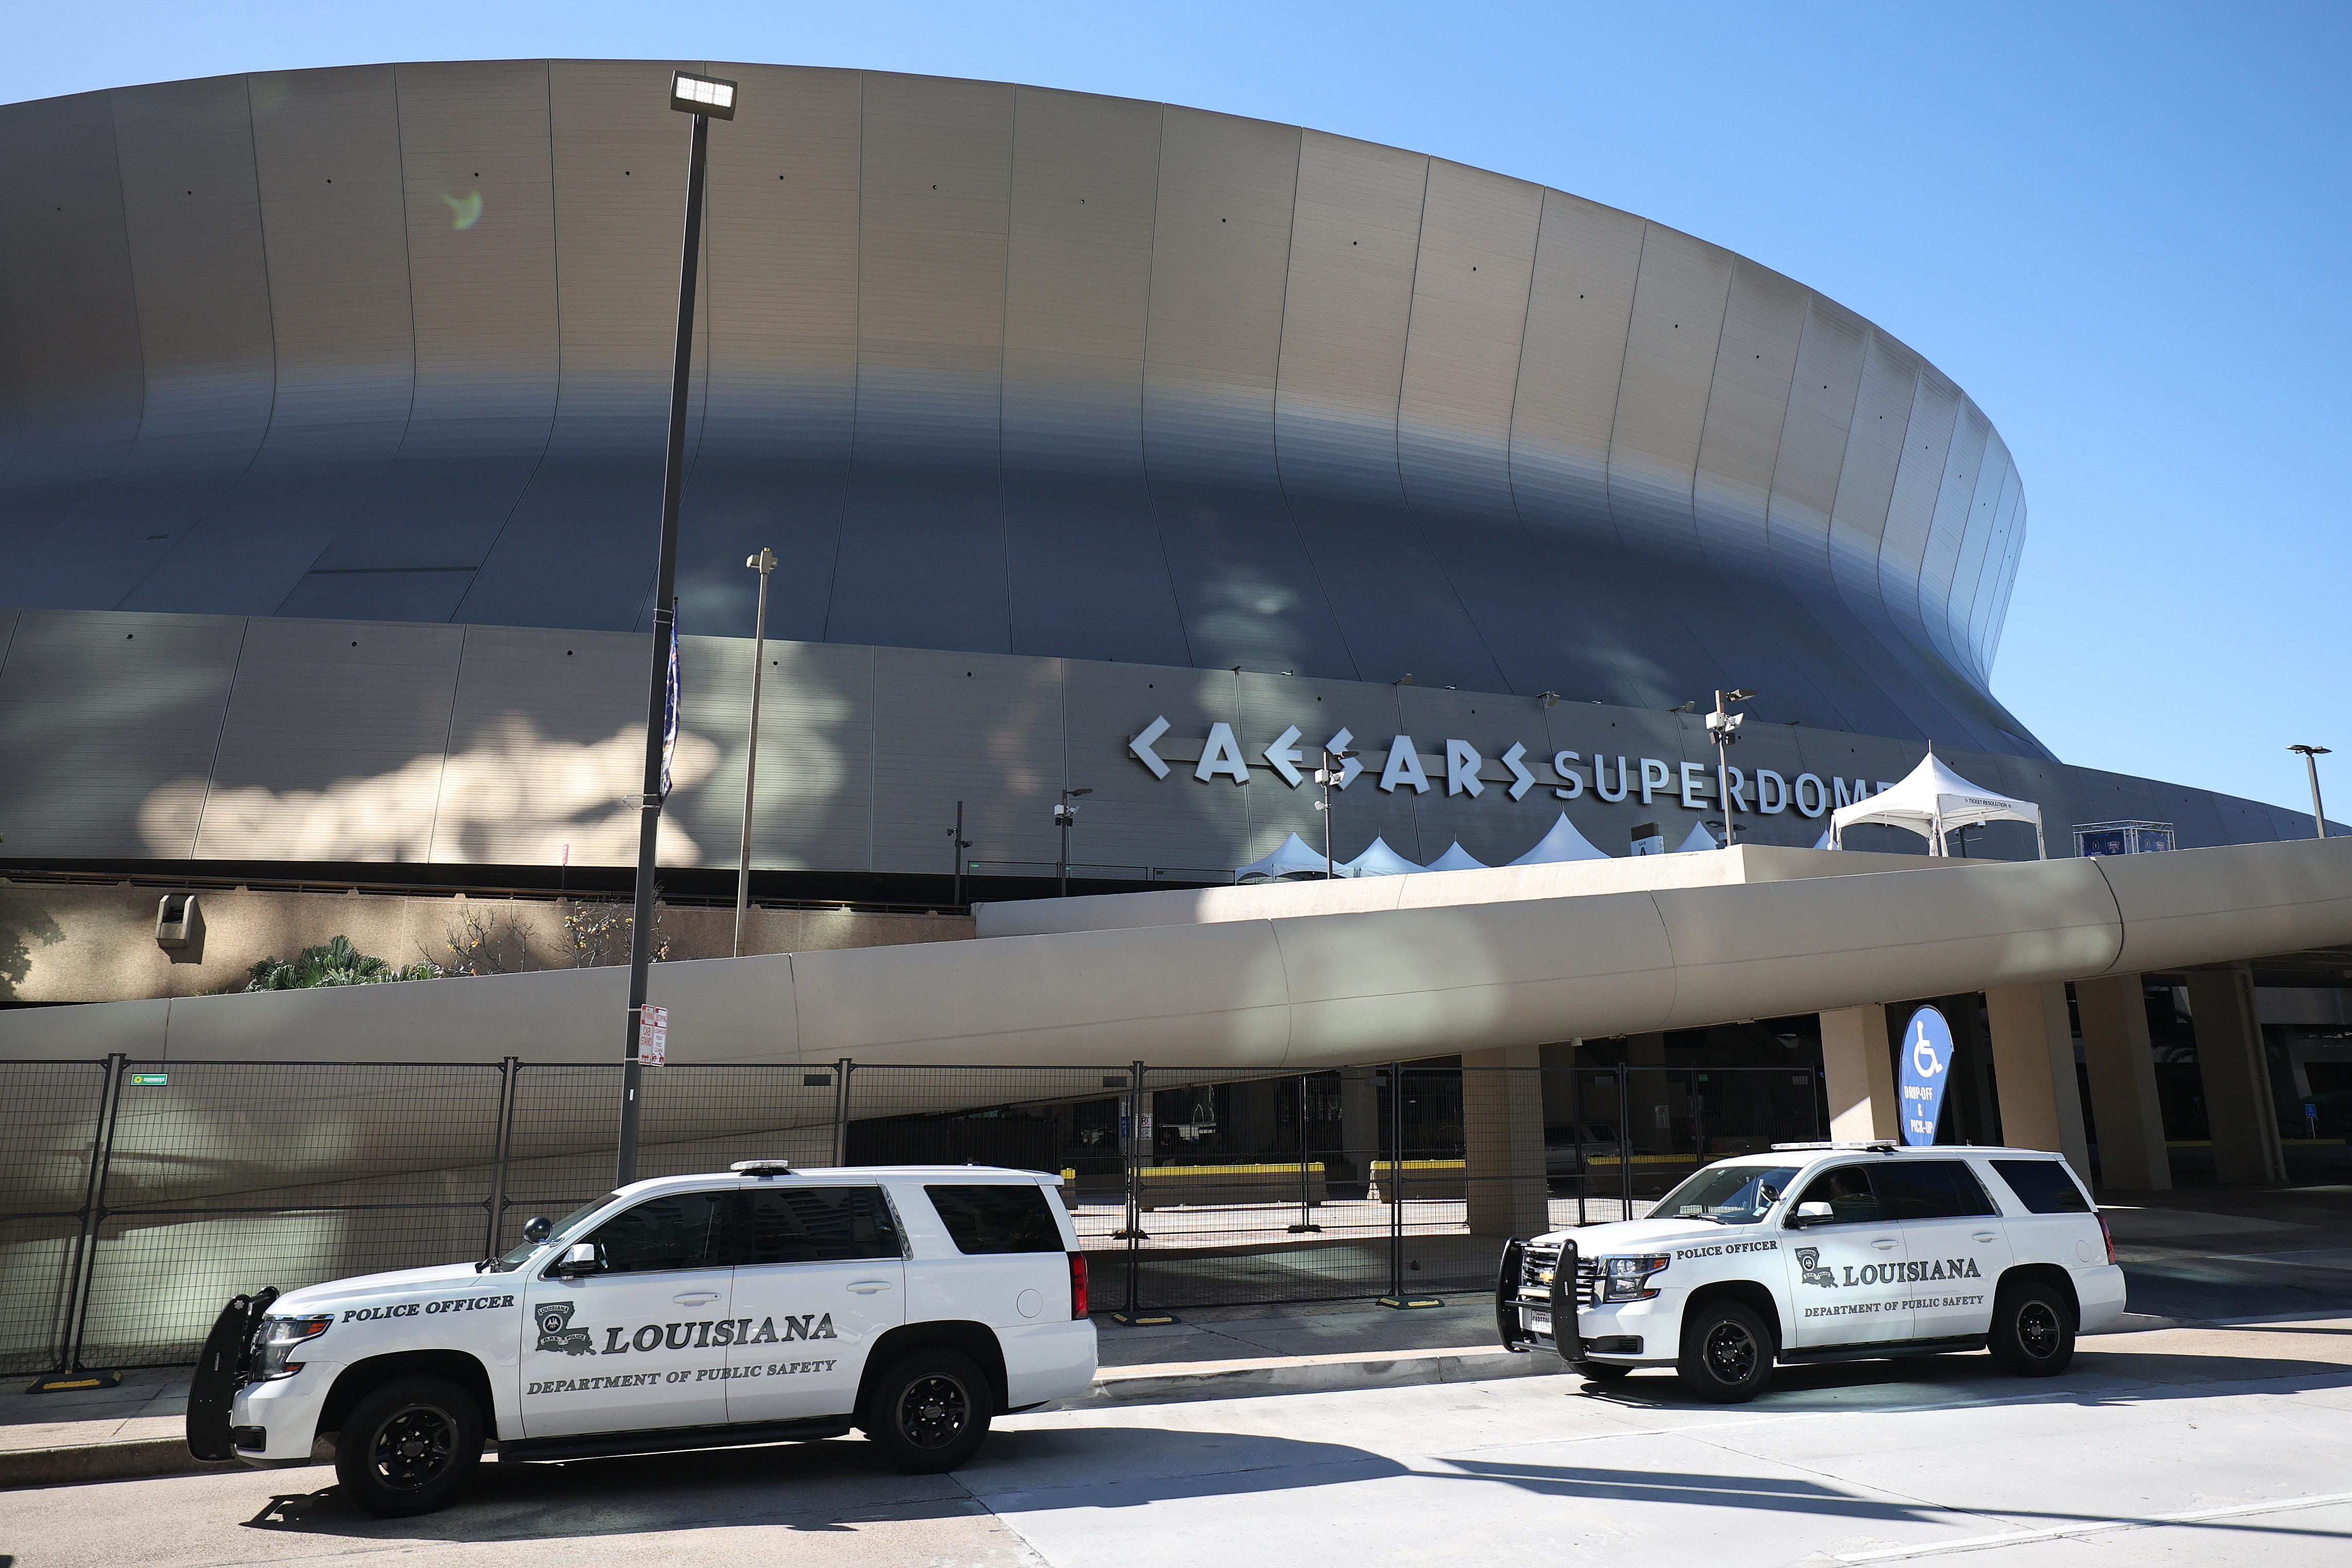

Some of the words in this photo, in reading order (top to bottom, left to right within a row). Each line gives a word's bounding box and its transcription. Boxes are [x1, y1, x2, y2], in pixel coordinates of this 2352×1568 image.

[1129, 714, 1536, 802] CAESARS
[1554, 750, 1897, 819] SUPERDOM
[640, 1036, 652, 1046] STAND
[1904, 1086, 1933, 1101] DROP-OFF
[1918, 1103, 1923, 1117] &
[1910, 1119, 1933, 1134] PICK-UP
[1677, 1246, 1723, 1260] POLICE
[1725, 1240, 1778, 1254] OFFICER
[1842, 1257, 1981, 1286] LOUISIANA
[342, 1303, 420, 1323] POLICE
[425, 1295, 514, 1314] OFFICER
[1804, 1302, 1881, 1317] DEPARTMENT
[1884, 1302, 1899, 1311] OF
[1902, 1298, 1940, 1310] PUBLIC
[1942, 1295, 1984, 1307] SAFETY
[1532, 1316, 1551, 1328] CAPITOL
[602, 1313, 837, 1354] LOUISIANA
[527, 1373, 660, 1395] DEPARTMENT
[665, 1370, 691, 1383] OF
[696, 1365, 763, 1381] PUBLIC
[767, 1359, 837, 1376] SAFETY
